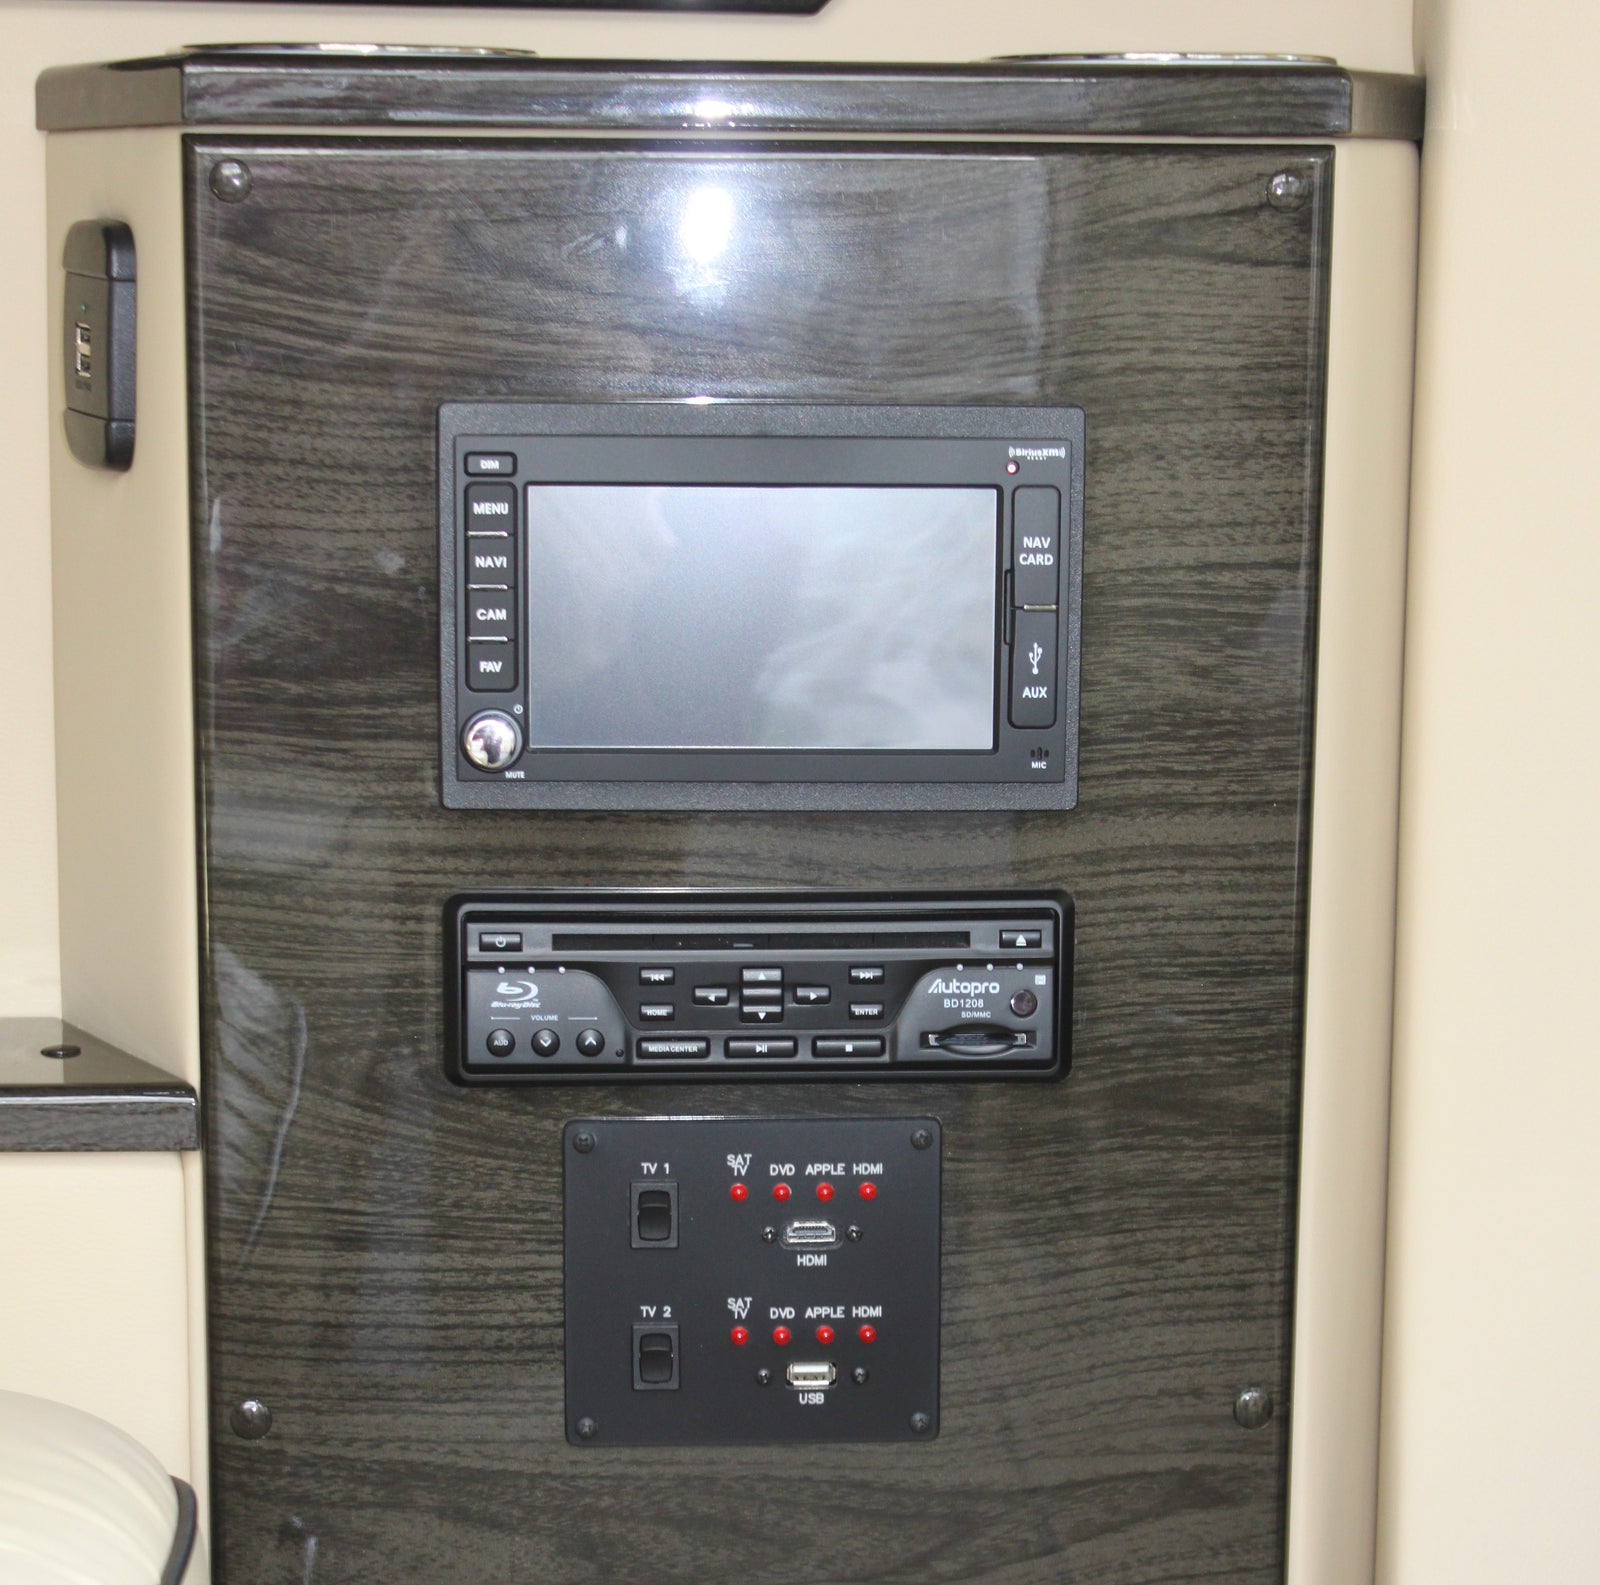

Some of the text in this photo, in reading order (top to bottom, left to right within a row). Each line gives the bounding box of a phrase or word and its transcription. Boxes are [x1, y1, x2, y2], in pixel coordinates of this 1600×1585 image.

[480, 460, 500, 470] DIM
[473, 502, 509, 516] MENU
[1023, 536, 1051, 549] NAV
[475, 556, 507, 569] NAVI
[1019, 553, 1054, 566] CARD
[476, 608, 507, 621] CAM
[479, 660, 502, 673] FAV
[1022, 686, 1048, 699] AUX
[1031, 761, 1047, 769] MIC
[505, 770, 525, 779] MUTE
[927, 978, 1000, 997] Autopro
[943, 999, 984, 1009] BD1208
[855, 1008, 878, 1016] ENTER
[961, 1011, 992, 1019] SD/MMC
[493, 1039, 509, 1047] AUD
[727, 1154, 752, 1166] SAT
[641, 1162, 670, 1174] TV 1
[732, 1163, 748, 1176] TV
[769, 1164, 795, 1176] DVD
[805, 1164, 845, 1175] APPLE
[853, 1163, 883, 1175] HDMI
[797, 1255, 827, 1266] HDMI
[727, 1297, 752, 1309] SAT
[640, 1306, 672, 1318] TV 2
[733, 1307, 749, 1319] TV
[769, 1307, 795, 1319] DVD
[805, 1307, 845, 1318] APPLE
[852, 1306, 882, 1318] HDMI
[799, 1393, 825, 1405] USB
